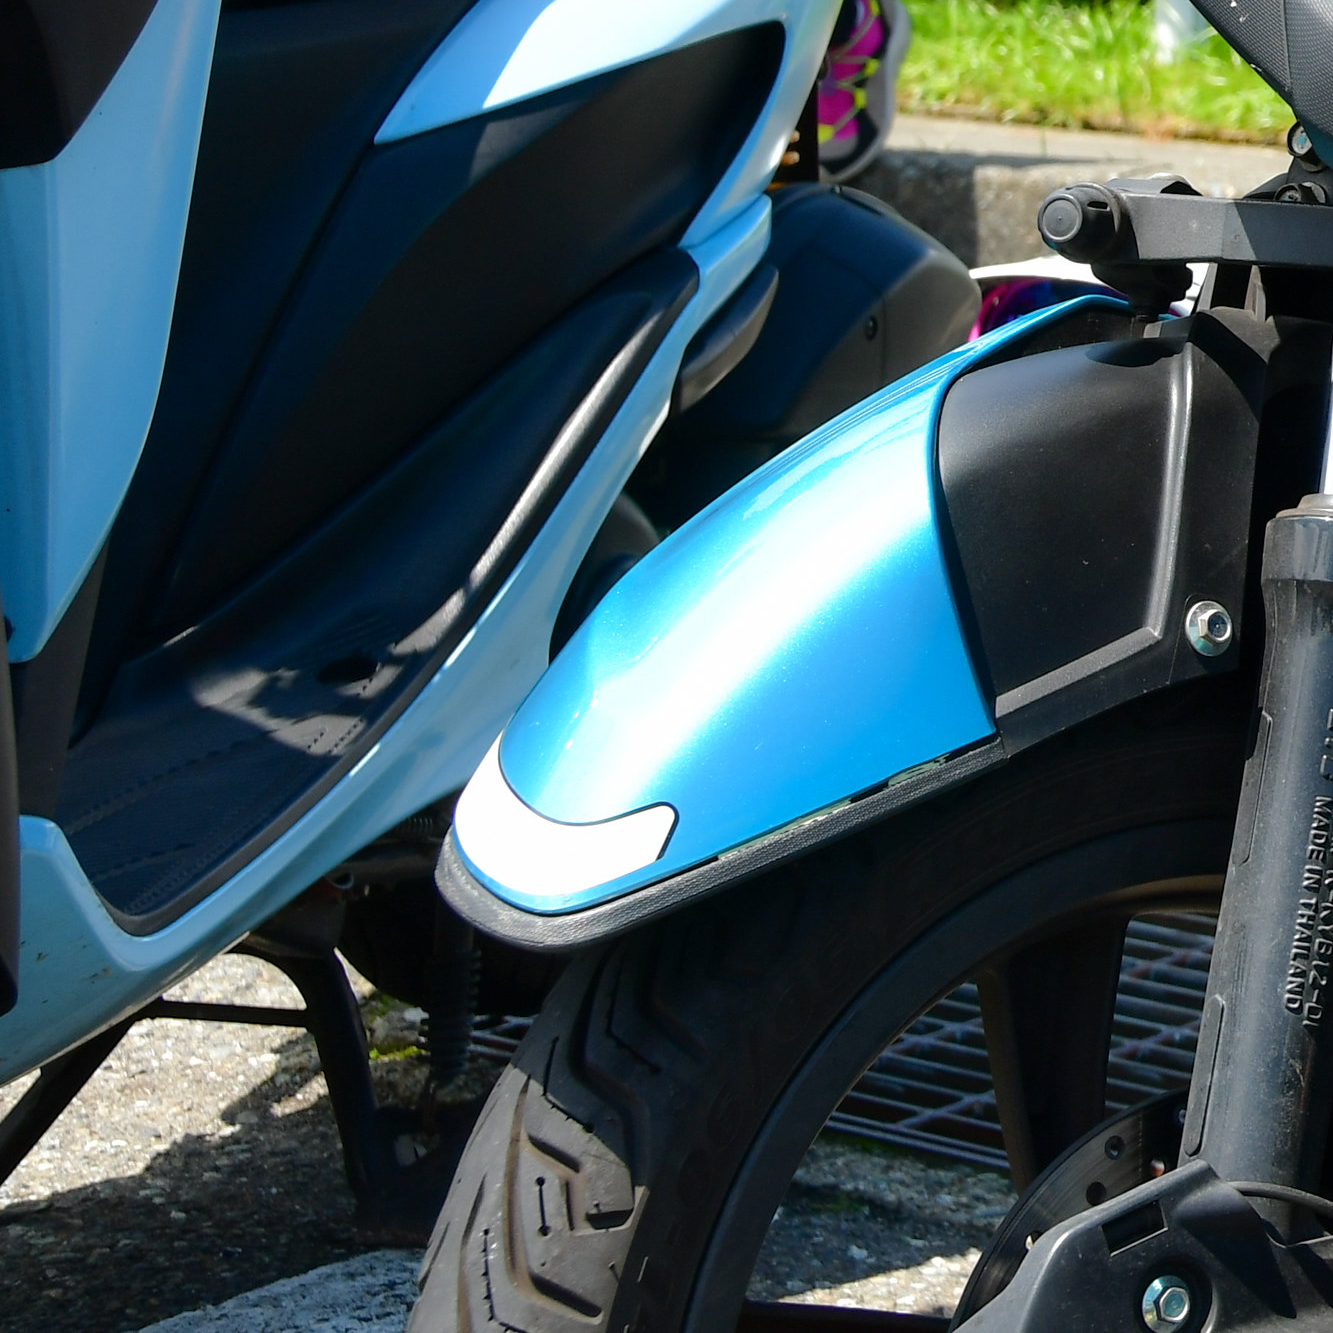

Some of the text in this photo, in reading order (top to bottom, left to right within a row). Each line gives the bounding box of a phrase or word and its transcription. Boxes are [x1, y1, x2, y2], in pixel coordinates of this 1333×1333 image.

[1307, 795, 1333, 862] MADE
[1301, 864, 1323, 890] IN
[1284, 896, 1317, 1010] THAILAND
